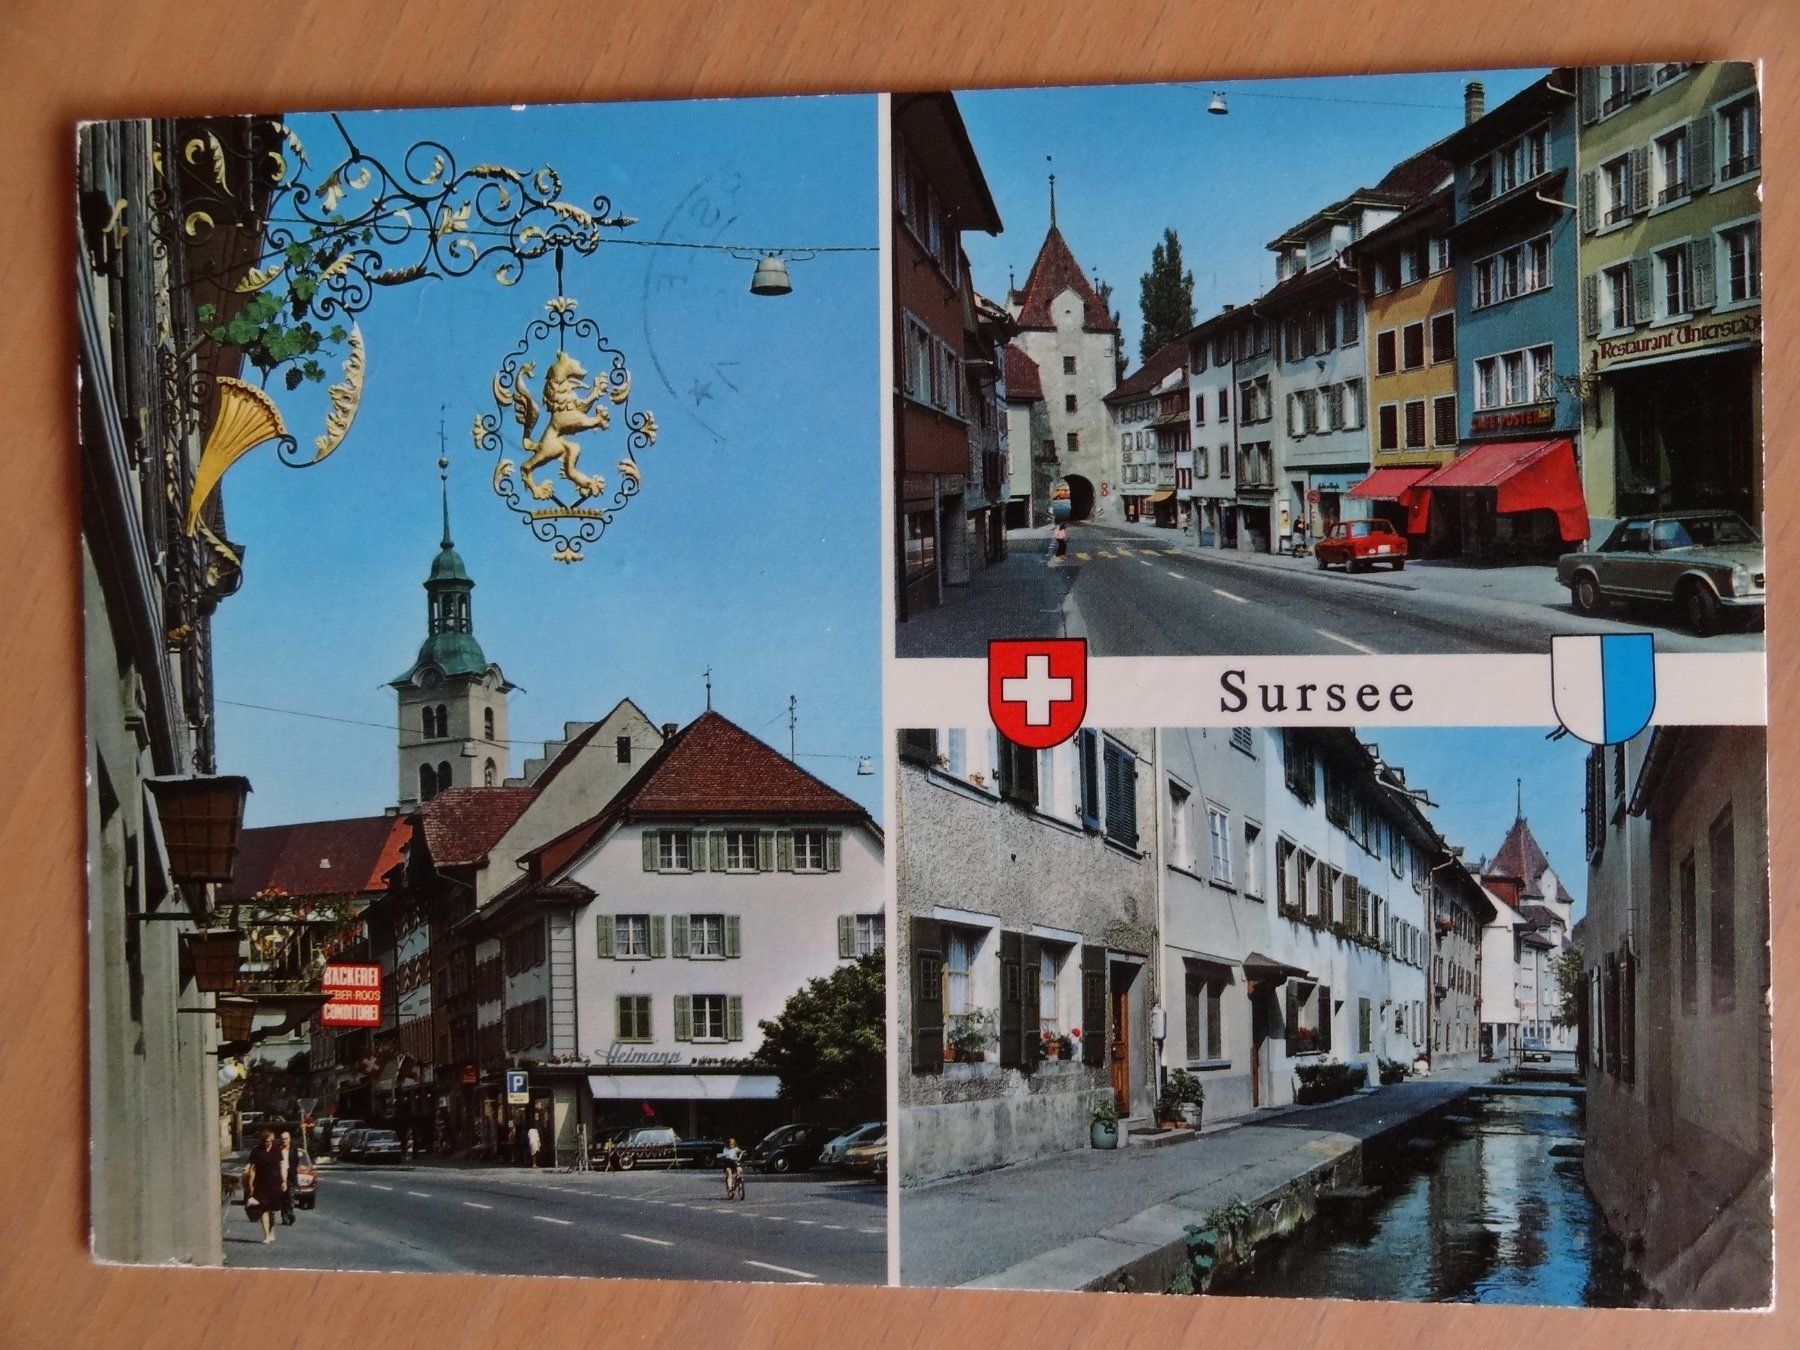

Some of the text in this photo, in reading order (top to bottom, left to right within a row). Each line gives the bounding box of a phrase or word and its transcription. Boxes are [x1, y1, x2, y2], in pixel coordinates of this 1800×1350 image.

[1599, 331, 1674, 360] Restaurant
[1219, 669, 1414, 713] Sursee
[594, 1041, 683, 1065] Heimann
[512, 1074, 524, 1092] P
